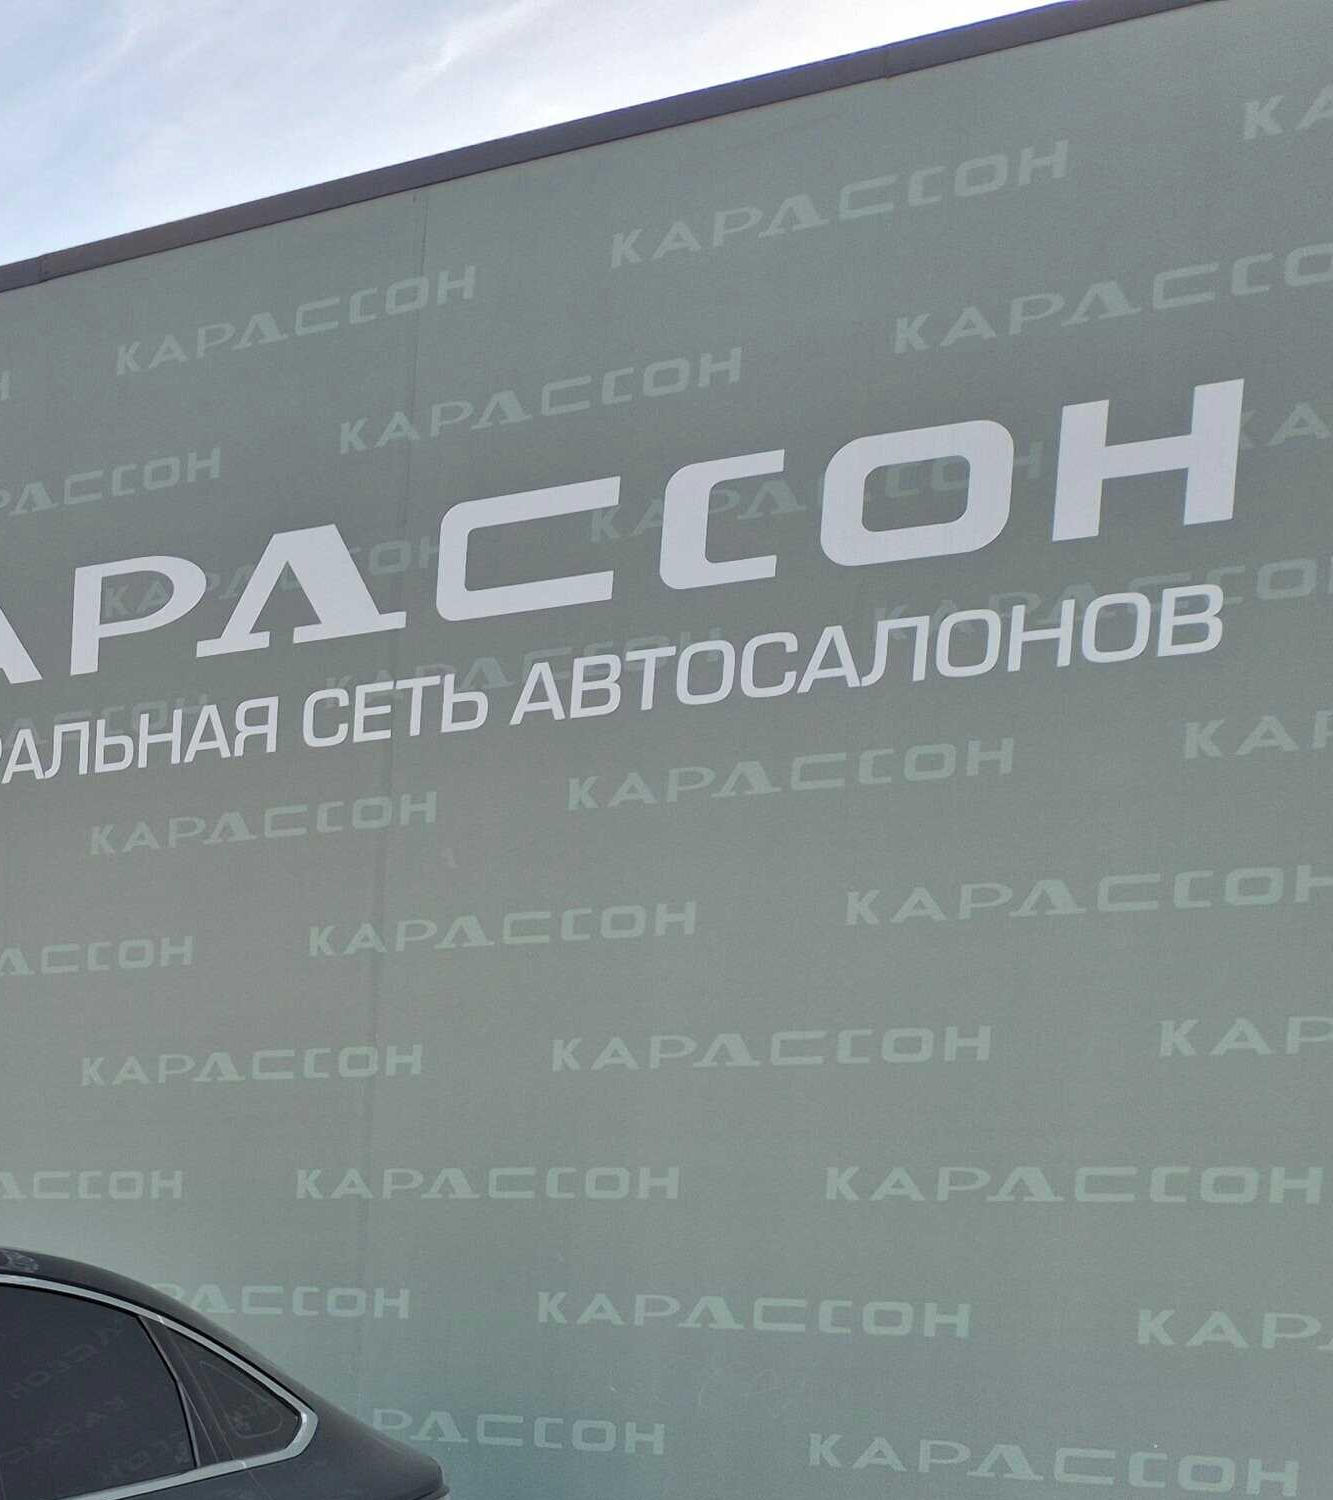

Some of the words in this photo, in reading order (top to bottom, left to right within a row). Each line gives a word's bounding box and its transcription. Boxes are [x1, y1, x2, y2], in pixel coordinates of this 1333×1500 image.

[611, 140, 1069, 269] КАРАССОН
[116, 265, 476, 376] КАРАССОН
[340, 351, 742, 455] КАРАССОН
[302, 674, 489, 747] СЕТЬ
[509, 583, 1224, 725] АВТОСАЛОНОВ
[568, 738, 1014, 810] КАРАССОН
[91, 790, 437, 855] КАРАССОН
[309, 901, 696, 956] КАРАССОН
[81, 1044, 423, 1086] КАРАССОН
[552, 1025, 991, 1072] КАРАССОН
[296, 1166, 679, 1200] КАРАССОН
[825, 1165, 1323, 1205] КАРАССОН
[538, 1291, 971, 1339] КАРАССОН
[809, 1433, 1299, 1497] КАРАССОН
